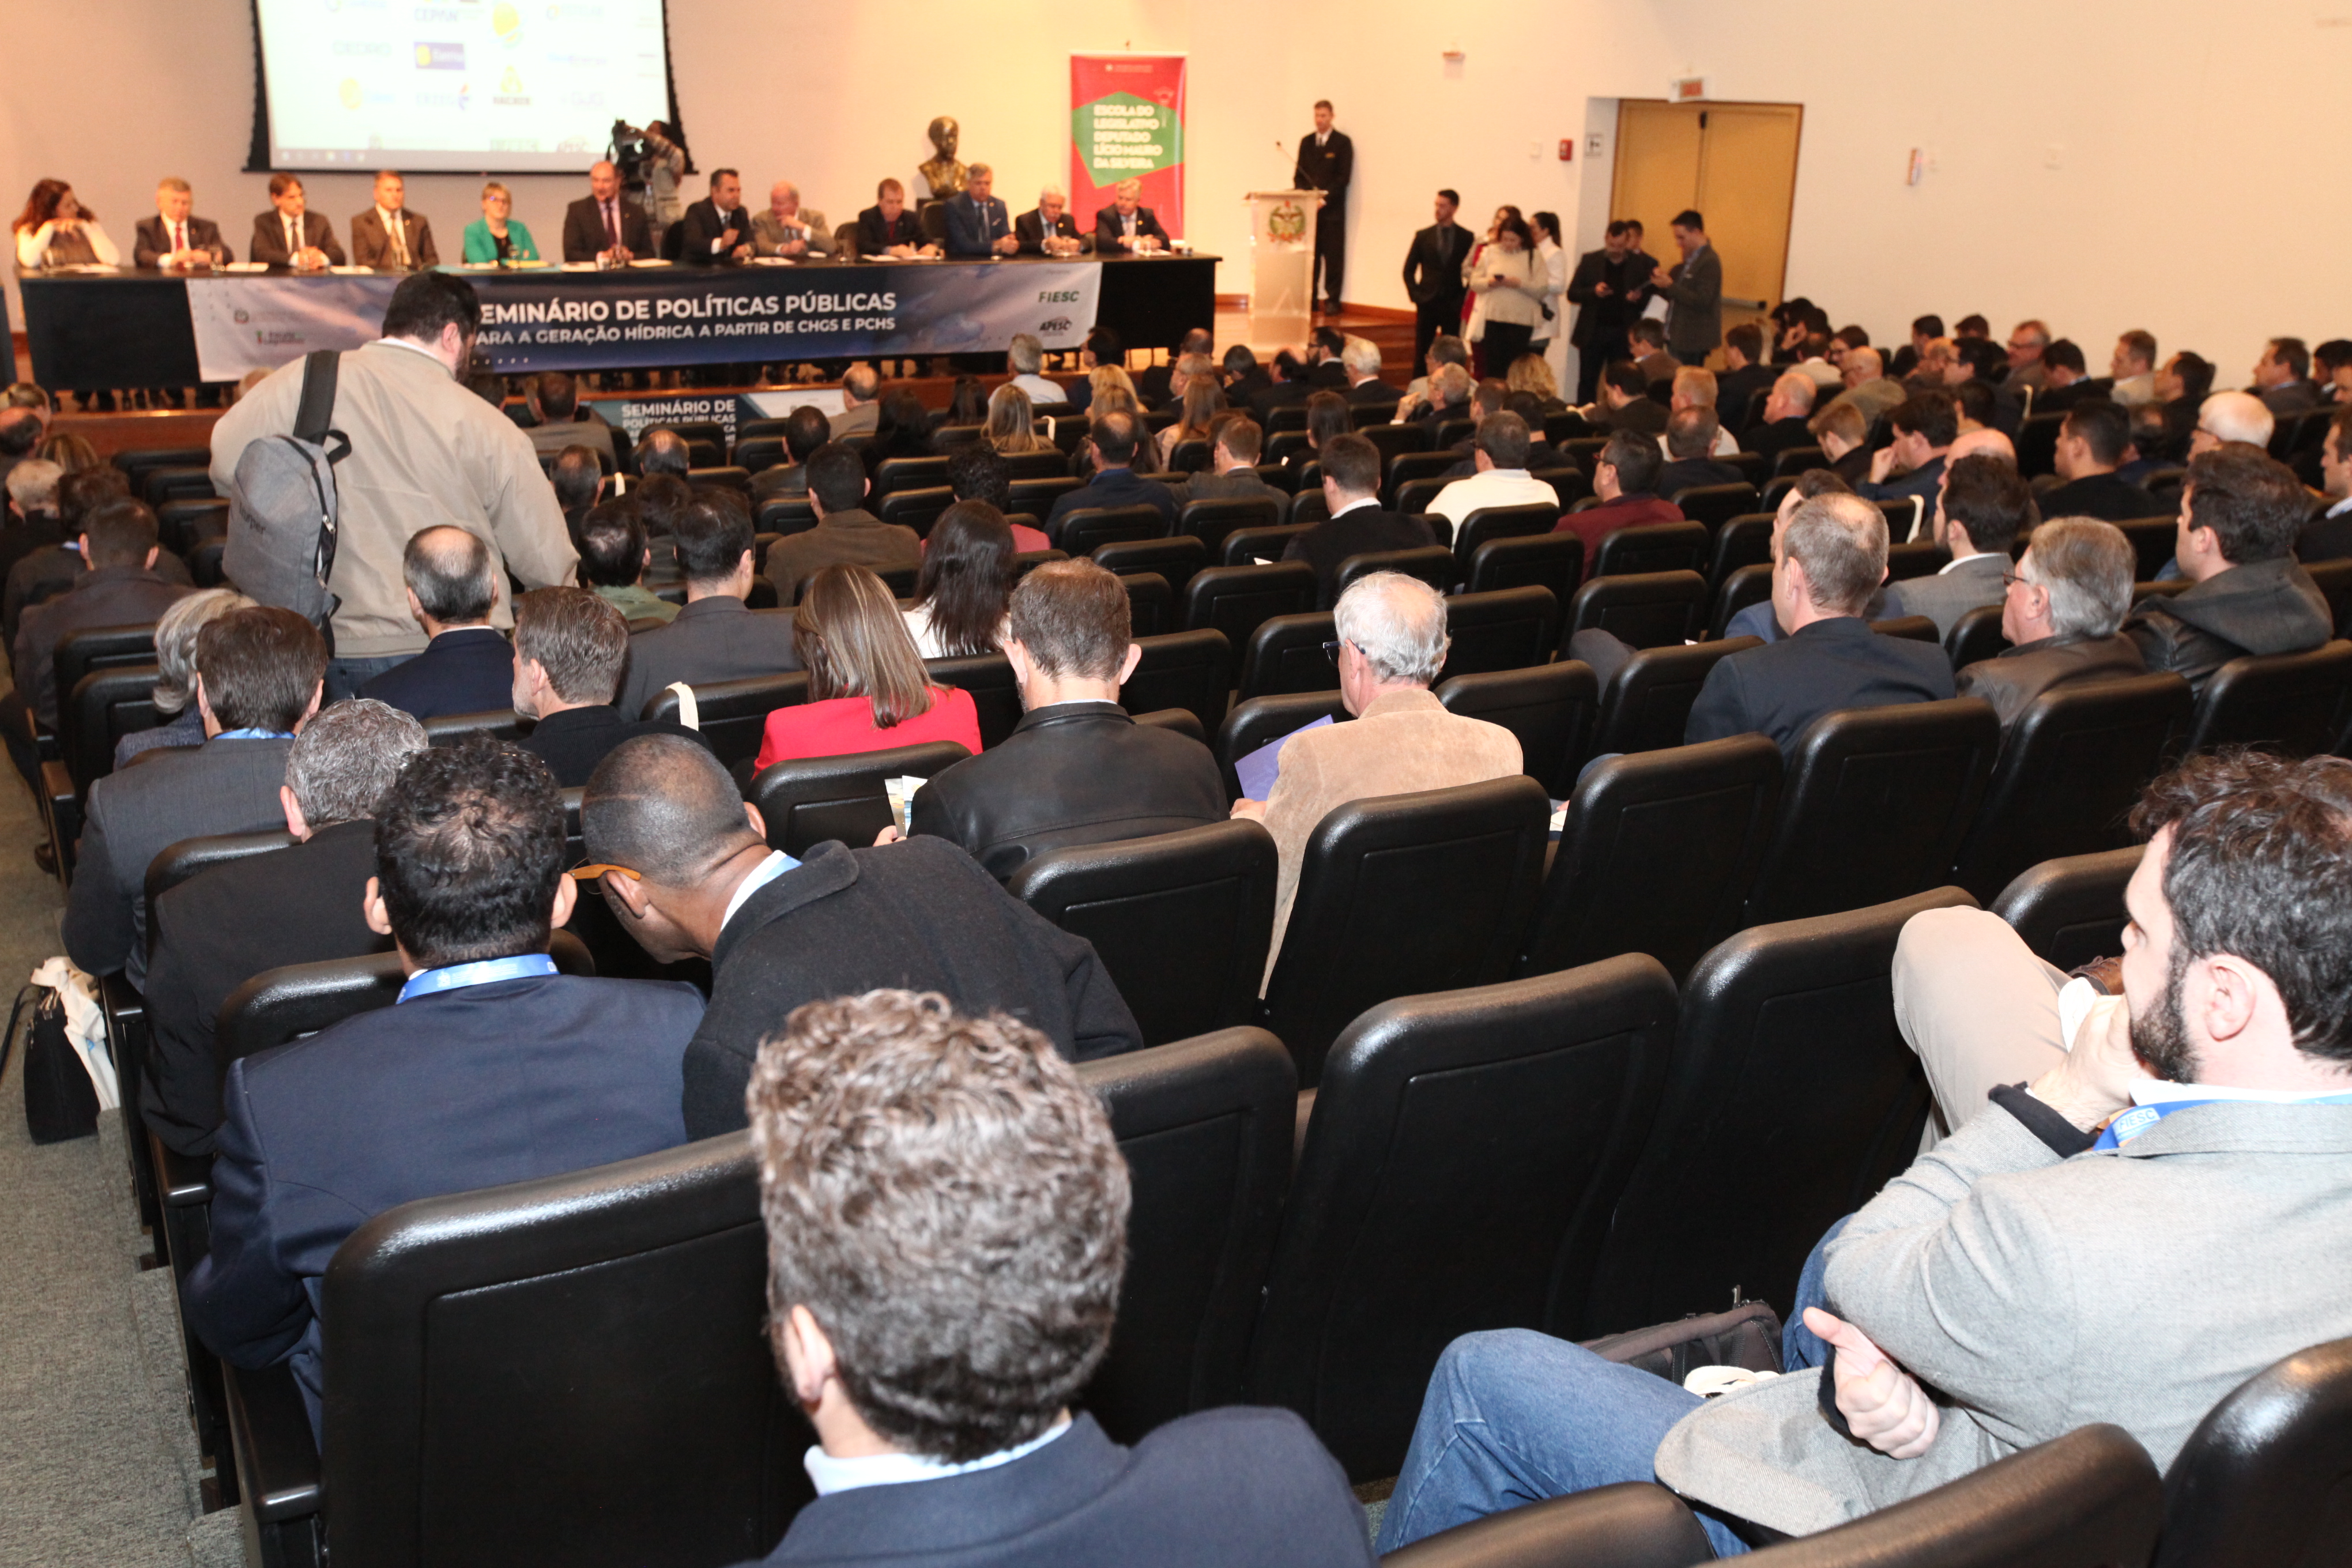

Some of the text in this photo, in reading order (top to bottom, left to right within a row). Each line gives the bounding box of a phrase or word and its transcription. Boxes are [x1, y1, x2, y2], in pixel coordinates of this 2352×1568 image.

[1094, 104, 1155, 117] ESCOLA DO
[1094, 118, 1160, 130] LEGISLATIVO
[1094, 131, 1151, 143] DEPUTADO
[1038, 291, 1080, 303] FIESC
[480, 289, 897, 324] EMINÁRIO DE POLÍTICAS PÚBLICAS
[476, 317, 896, 345] ARA A GERAÇÃO HÍDRICA A PARTIR DE CHGS E PCHS
[621, 399, 736, 418] SEMINÁRIO DE
[2119, 1109, 2155, 1130] FIESC
